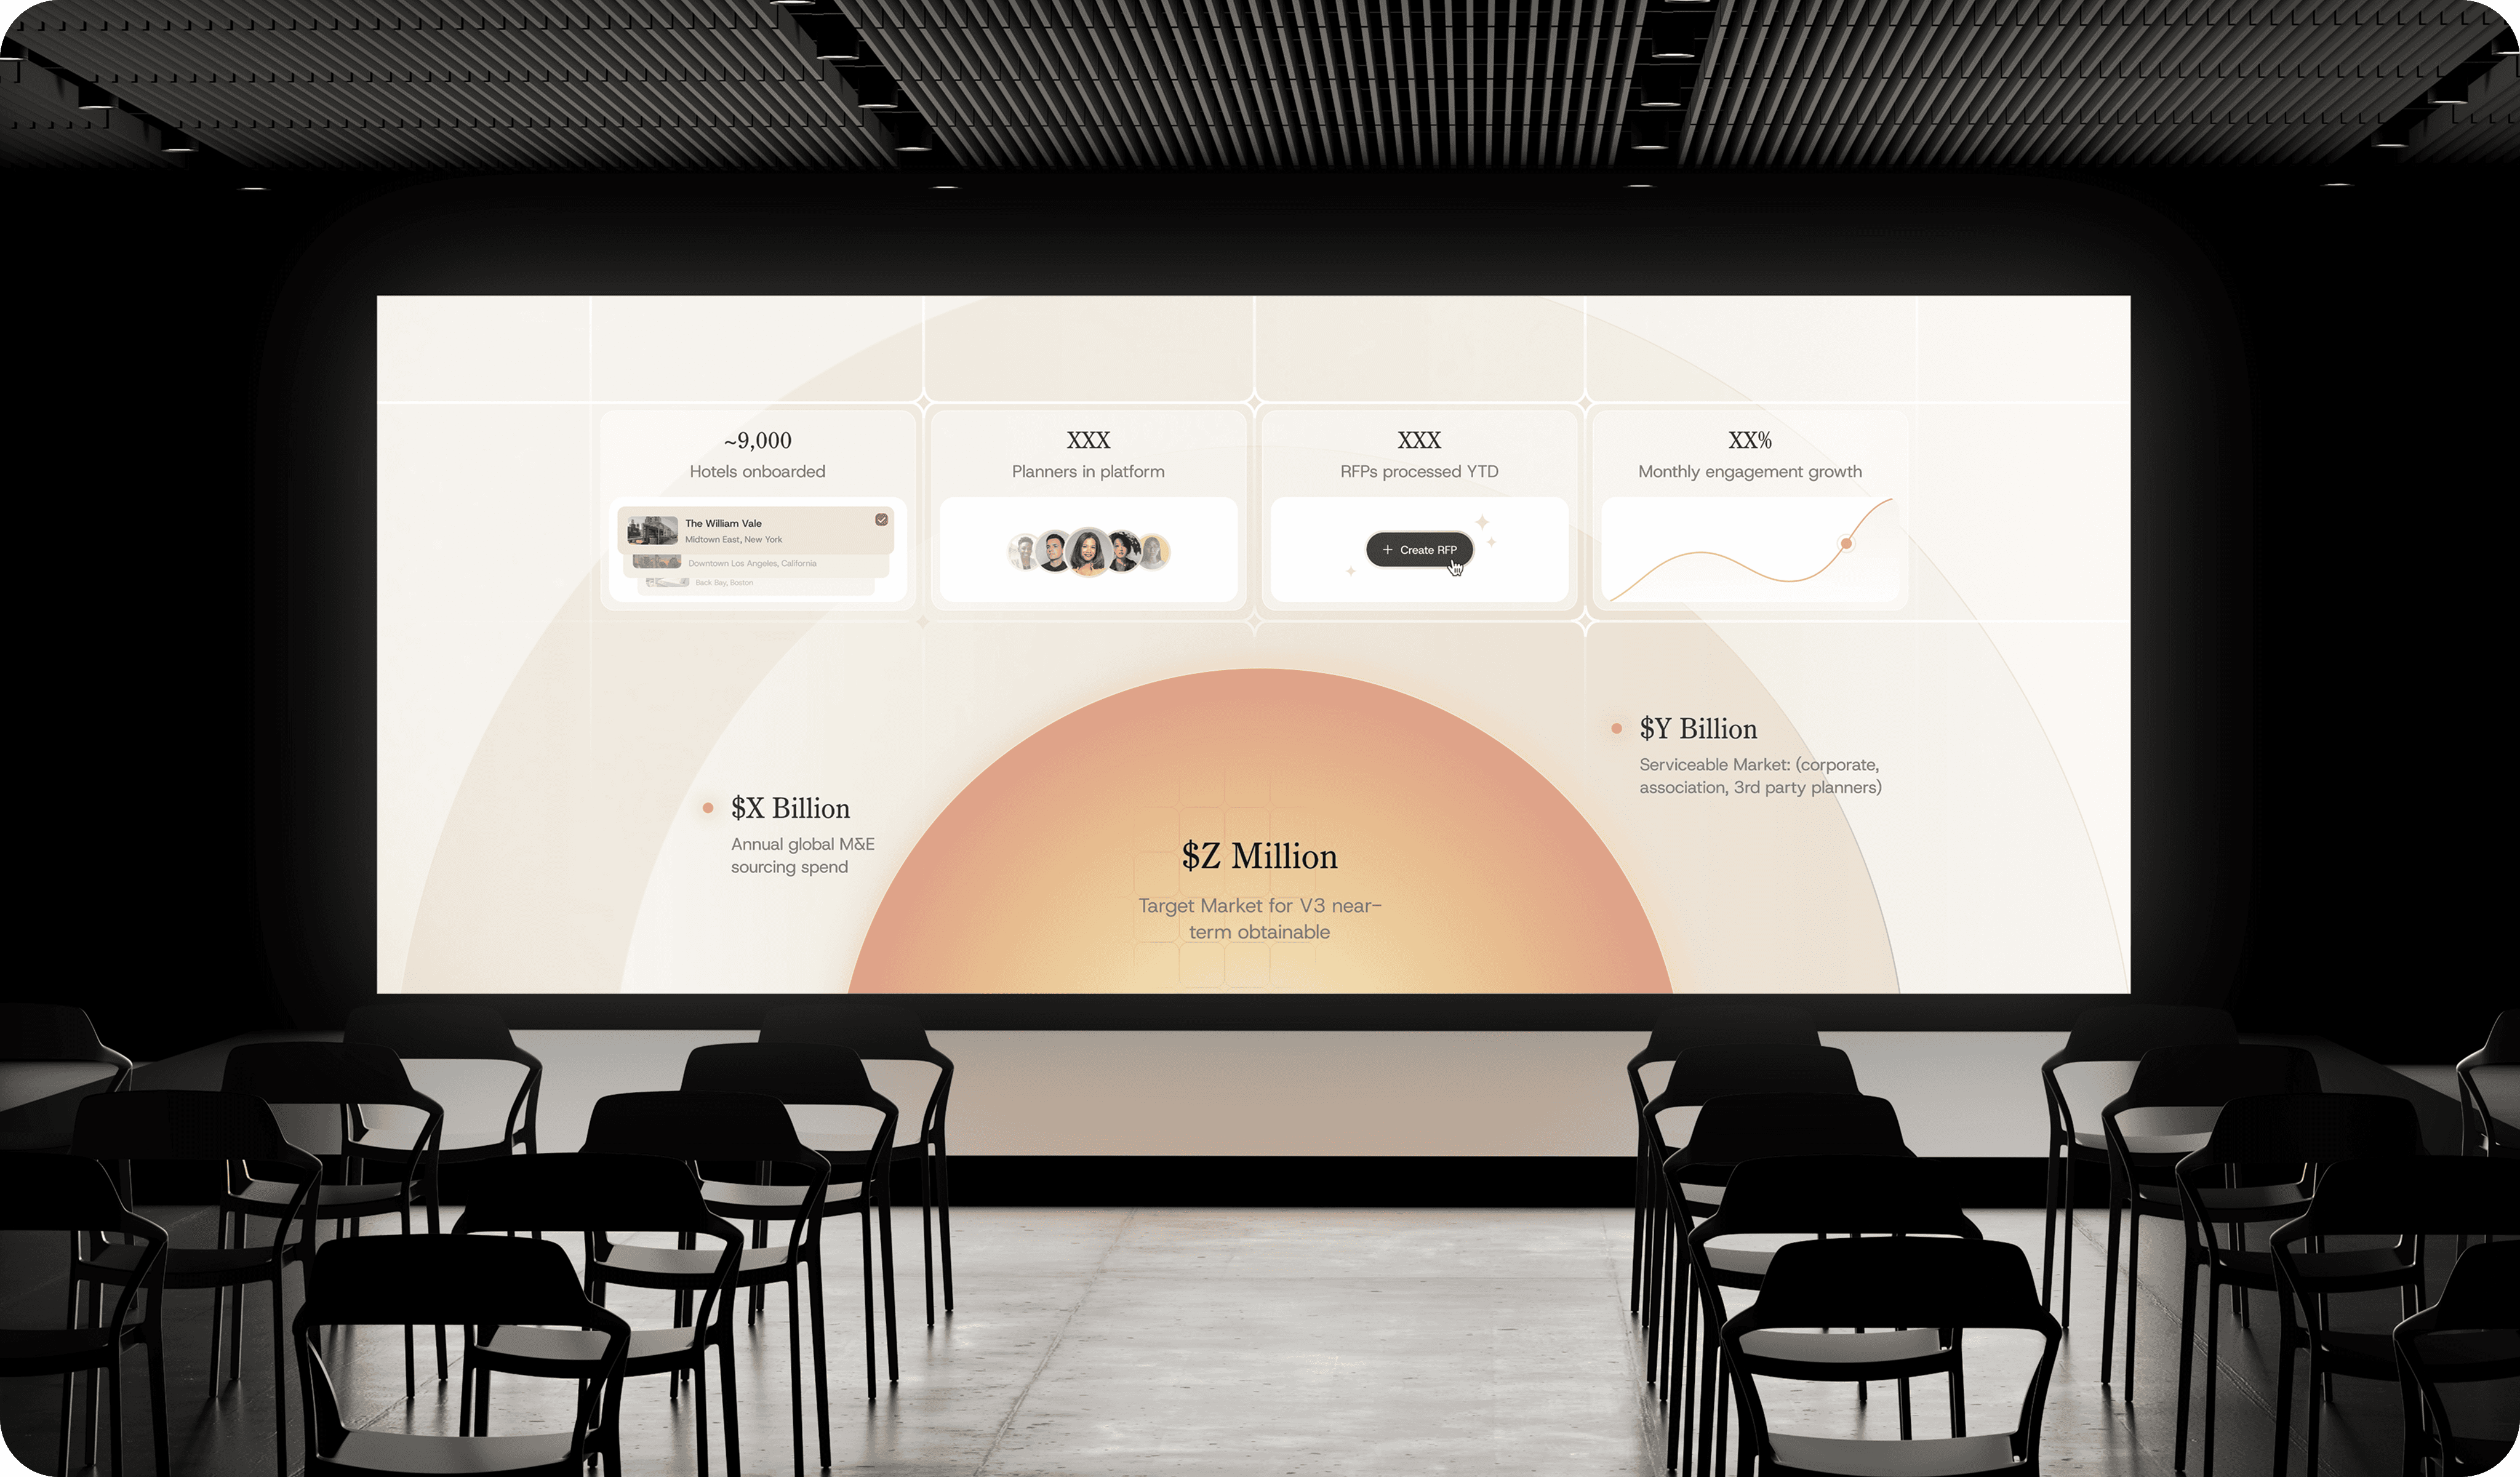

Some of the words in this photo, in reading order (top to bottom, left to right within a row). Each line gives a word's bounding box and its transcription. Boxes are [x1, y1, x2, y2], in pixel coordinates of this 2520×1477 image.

[724, 431, 792, 452] ~9,000
[1066, 431, 1111, 449] XXX
[1397, 431, 1442, 449] XXX
[1728, 430, 1772, 449] XX%
[690, 464, 738, 478] Hotels
[742, 464, 826, 478] onboarded
[1012, 464, 1078, 478] Planners
[1082, 465, 1095, 478] in
[1100, 464, 1165, 482] platform
[1341, 464, 1378, 478] RFPs
[1383, 464, 1462, 482] processed
[1466, 464, 1499, 478] YTD
[1639, 464, 1701, 482] Monthly
[1705, 466, 1804, 482] engagement
[1808, 464, 1863, 482] growth
[685, 519, 703, 528] The
[705, 519, 739, 528] William
[742, 519, 762, 528] Vale
[685, 535, 721, 543] Midtown
[722, 535, 743, 545] East,
[744, 535, 763, 543] New
[764, 535, 783, 543] York
[1400, 545, 1435, 555] Create
[1438, 545, 1458, 554] RFP
[688, 559, 729, 567] Downtown
[731, 559, 745, 567] Los
[746, 559, 780, 569] Angeles,
[781, 559, 817, 567] California
[714, 579, 729, 587] Bay,
[1640, 714, 1673, 742] $Y
[1679, 717, 1758, 740] Billion
[1639, 757, 1729, 771] Serviceable
[1734, 757, 1791, 771] Market:
[1796, 756, 1879, 775] (corporate,
[1639, 780, 1729, 796] association,
[1734, 780, 1761, 794] 3rd
[1766, 782, 1807, 798] party
[1812, 778, 1882, 798] planners)
[732, 794, 766, 822] $X
[772, 796, 851, 819] Billion
[730, 837, 783, 851] Annual
[788, 836, 834, 855] global
[839, 837, 875, 851] M&E
[1182, 839, 1221, 872] $Z
[1231, 842, 1338, 870] Million
[731, 860, 796, 878] sourcing
[801, 860, 849, 877] spend
[1138, 897, 1195, 918] Target
[1201, 897, 1263, 913] Market
[1268, 897, 1294, 913] for
[1300, 897, 1326, 913] V3
[1332, 902, 1382, 913] near-
[1189, 926, 1231, 940] term
[1238, 923, 1330, 940] obtainable
